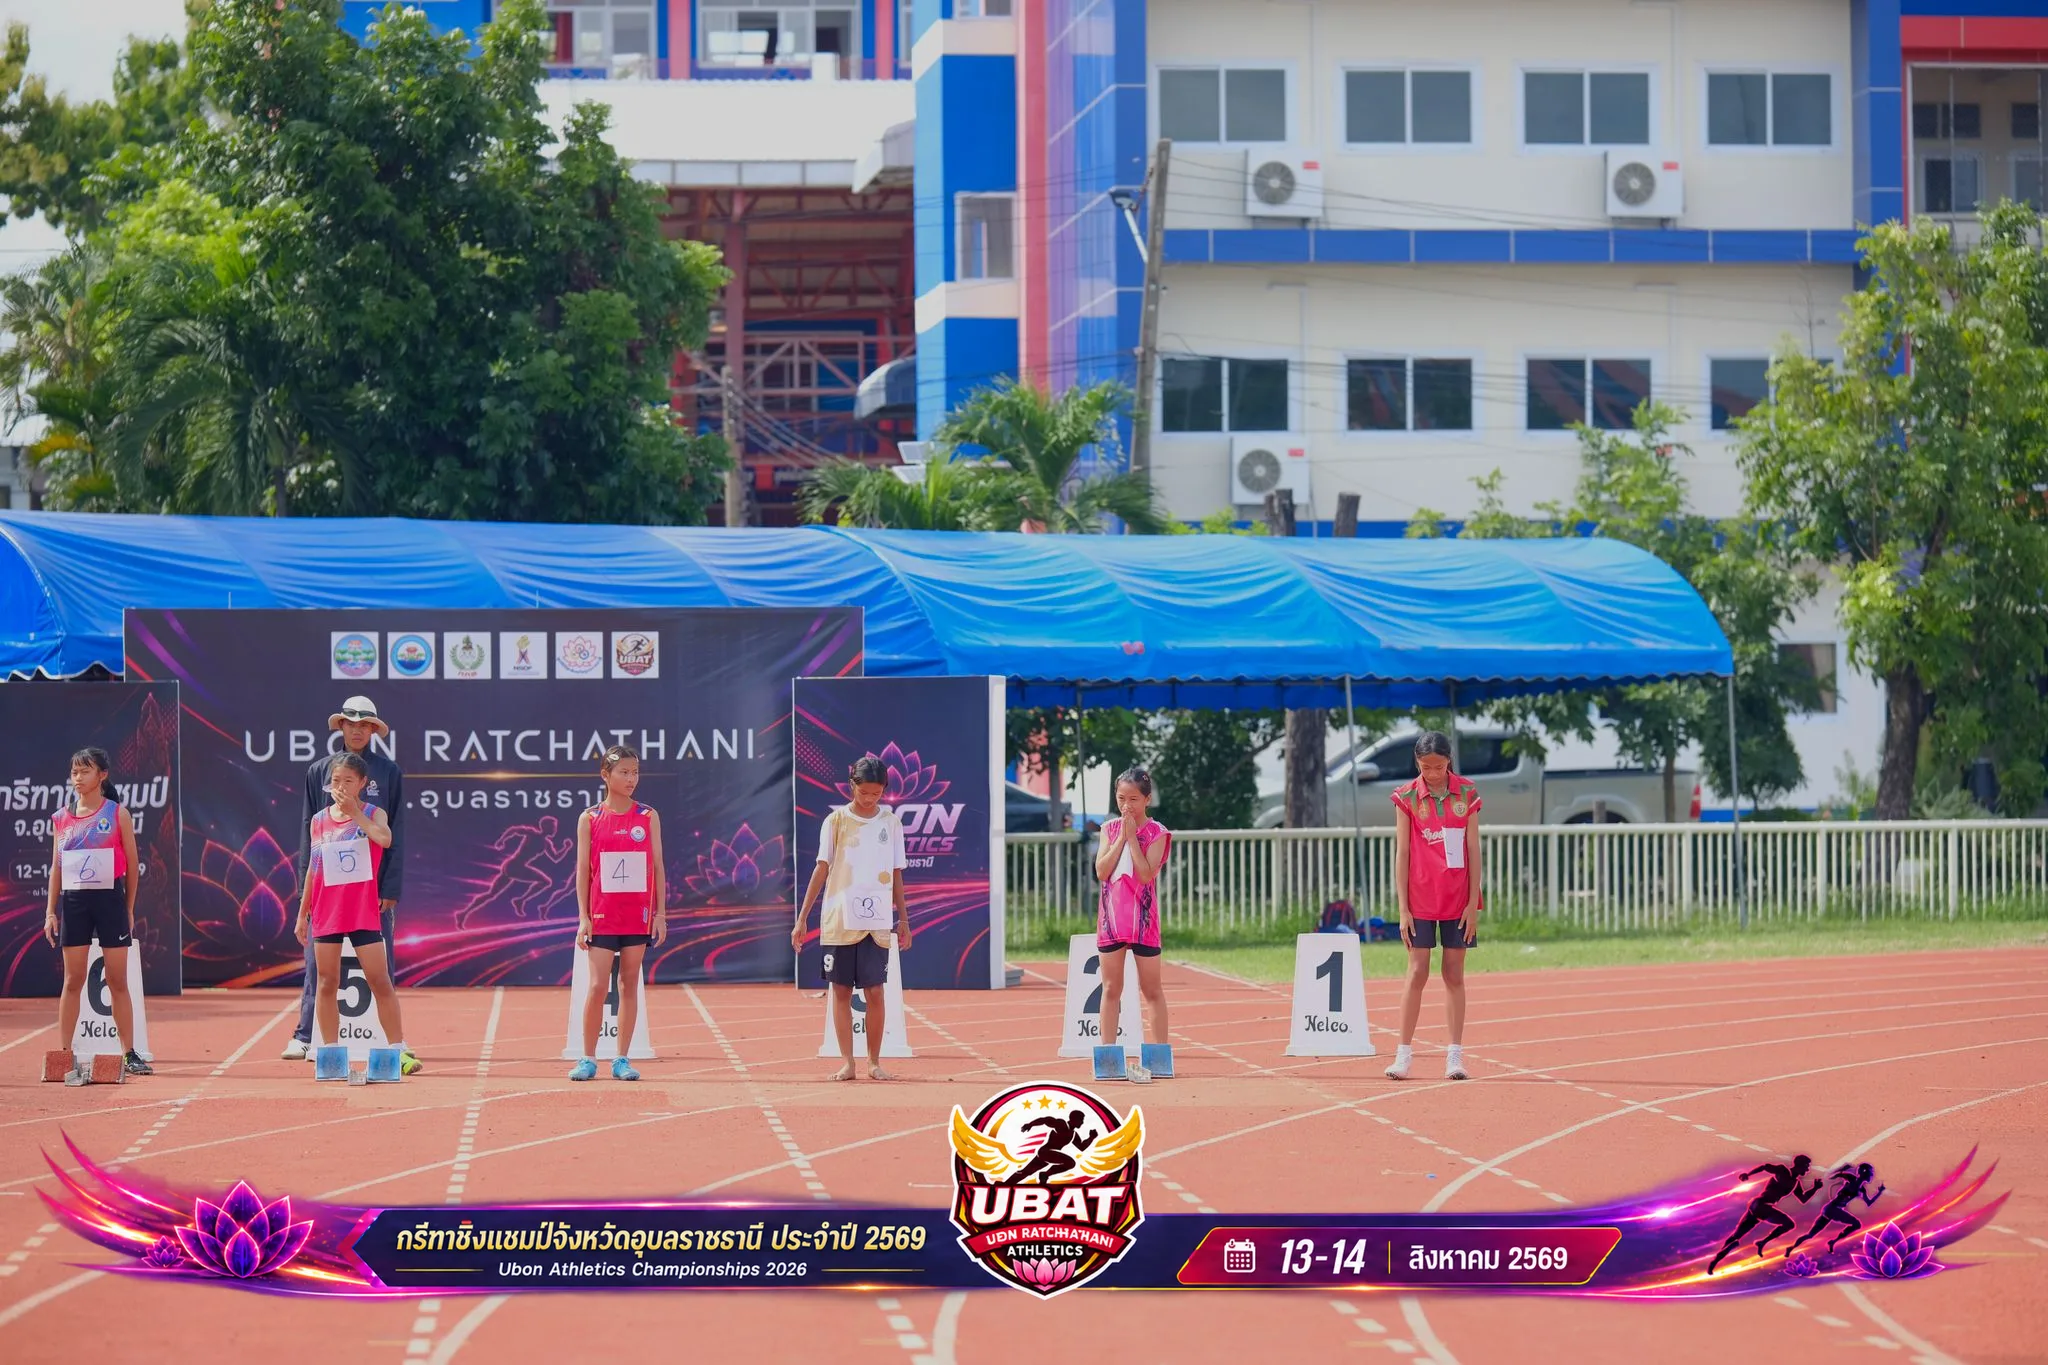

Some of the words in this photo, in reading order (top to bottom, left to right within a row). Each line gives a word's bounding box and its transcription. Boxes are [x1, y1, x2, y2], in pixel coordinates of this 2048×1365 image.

[425, 729, 754, 761] RATCHATHANI
[79, 855, 95, 881] 6
[338, 850, 356, 873] 5
[612, 858, 629, 884] 4
[860, 897, 875, 919] 3
[336, 956, 372, 1017] 5
[1082, 954, 1122, 1014] 2
[1316, 951, 1344, 1012] 1
[80, 1020, 118, 1038] Nelc
[339, 1022, 373, 1039] elco
[1304, 1014, 1349, 1033] Nelco
